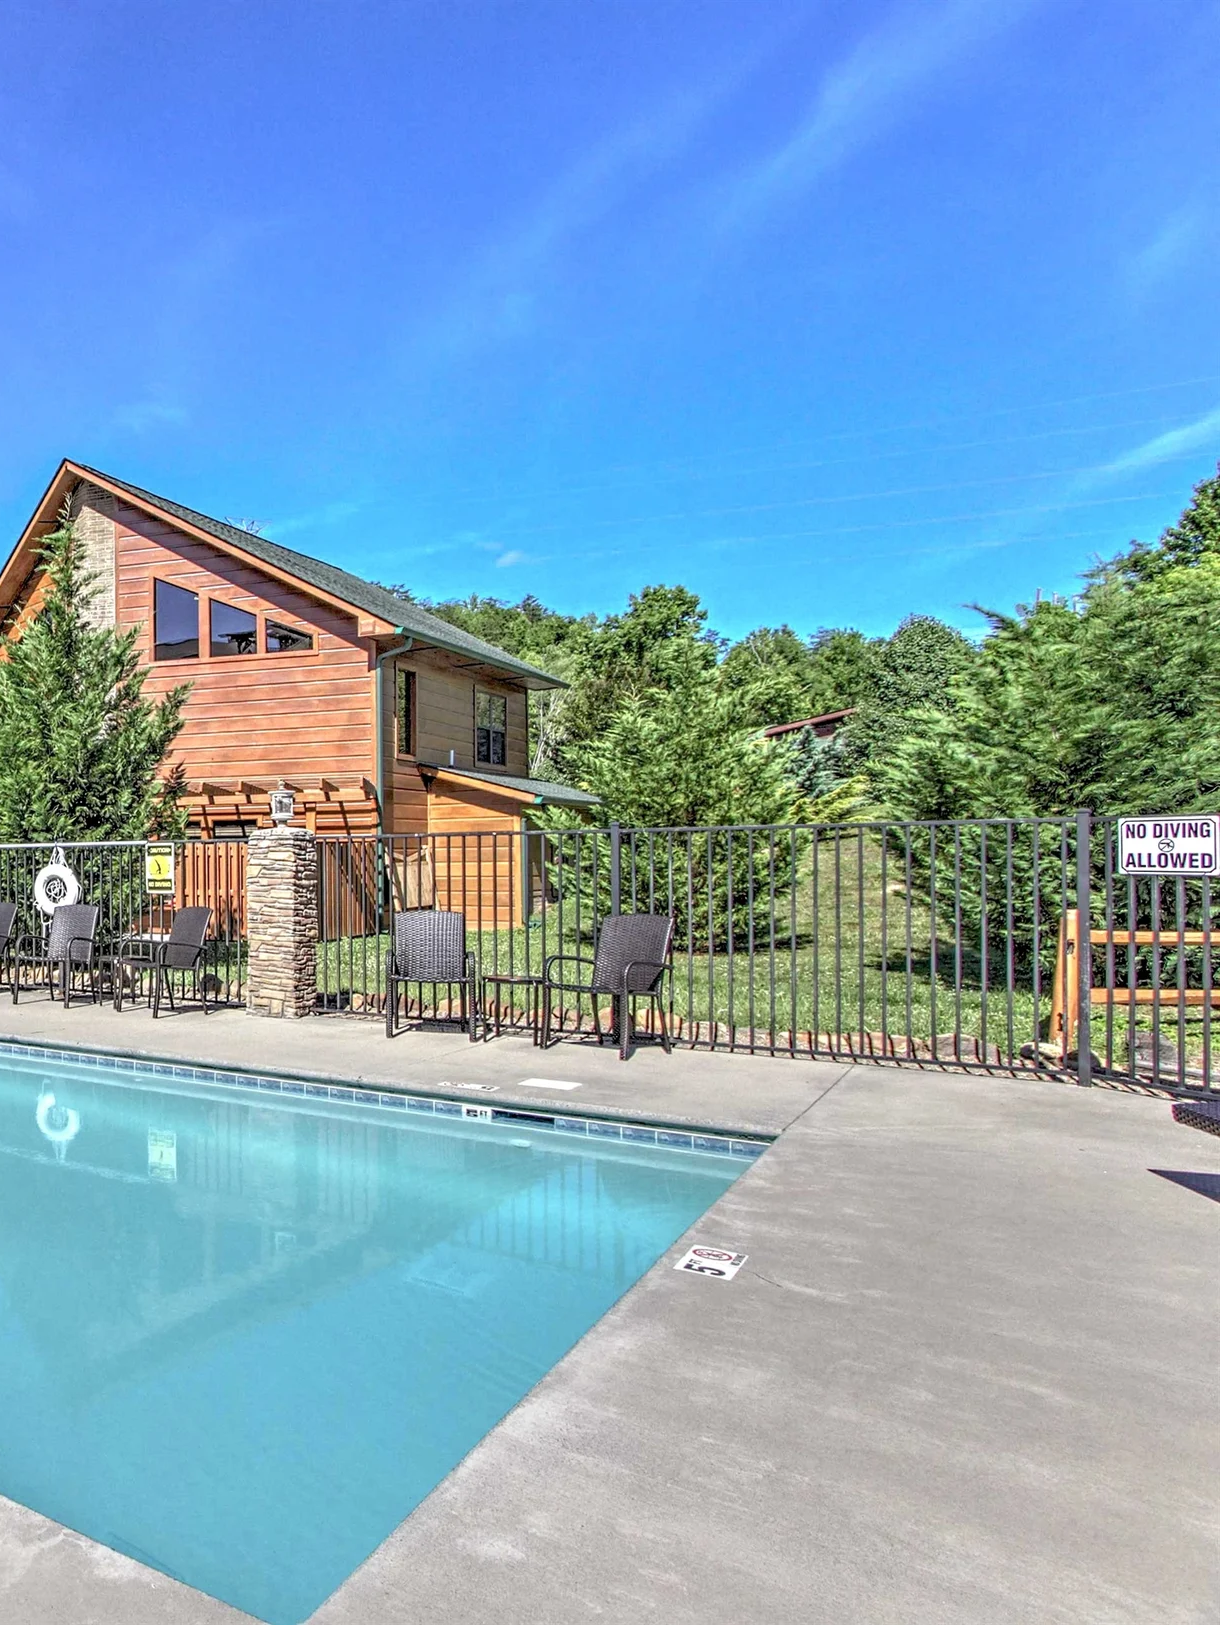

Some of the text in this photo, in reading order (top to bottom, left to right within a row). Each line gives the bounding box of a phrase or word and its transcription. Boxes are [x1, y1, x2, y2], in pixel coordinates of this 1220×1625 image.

[1125, 822, 1211, 839] NO DIVING
[1125, 852, 1213, 868] ALLOWED
[683, 1263, 726, 1276] 5
